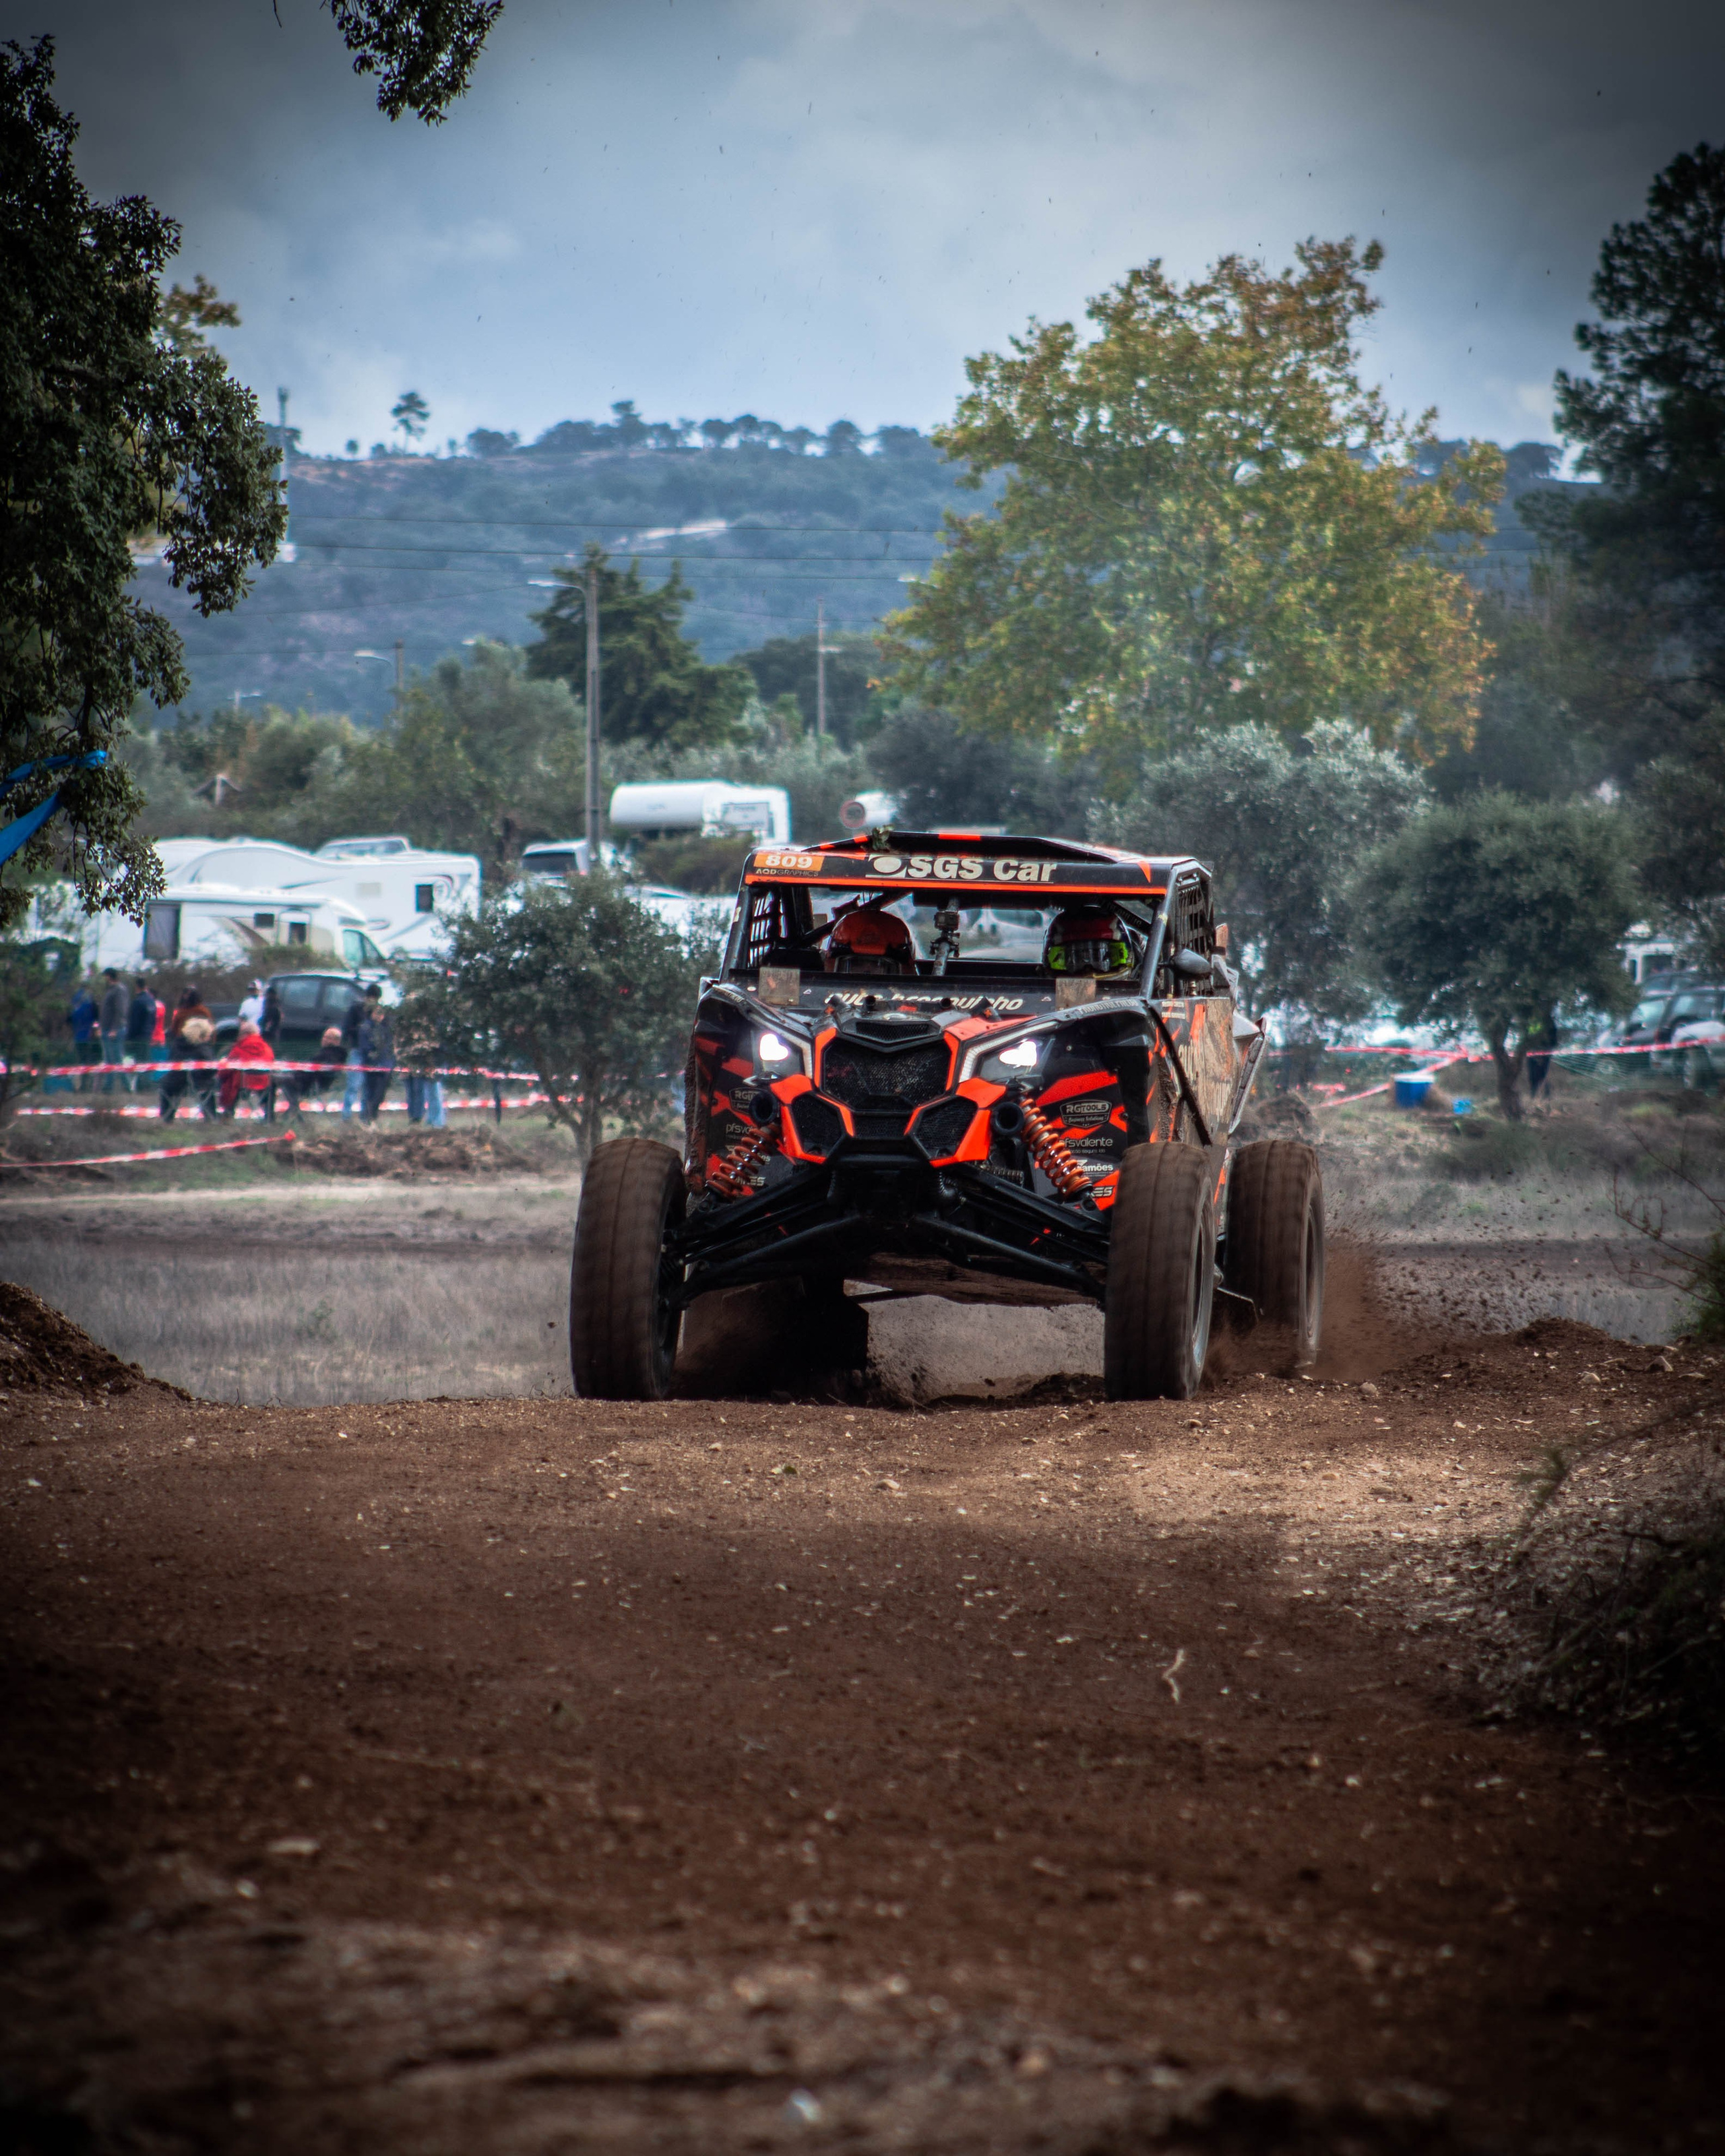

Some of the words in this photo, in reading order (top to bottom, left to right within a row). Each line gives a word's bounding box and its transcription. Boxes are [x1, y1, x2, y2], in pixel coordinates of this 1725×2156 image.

[765, 853, 813, 868] 809
[907, 856, 984, 880] SGS
[993, 859, 1058, 882] Car
[1066, 1103, 1108, 1114] RGTOOLS
[726, 1123, 754, 1134] pfsva
[1077, 1163, 1114, 1172] amões
